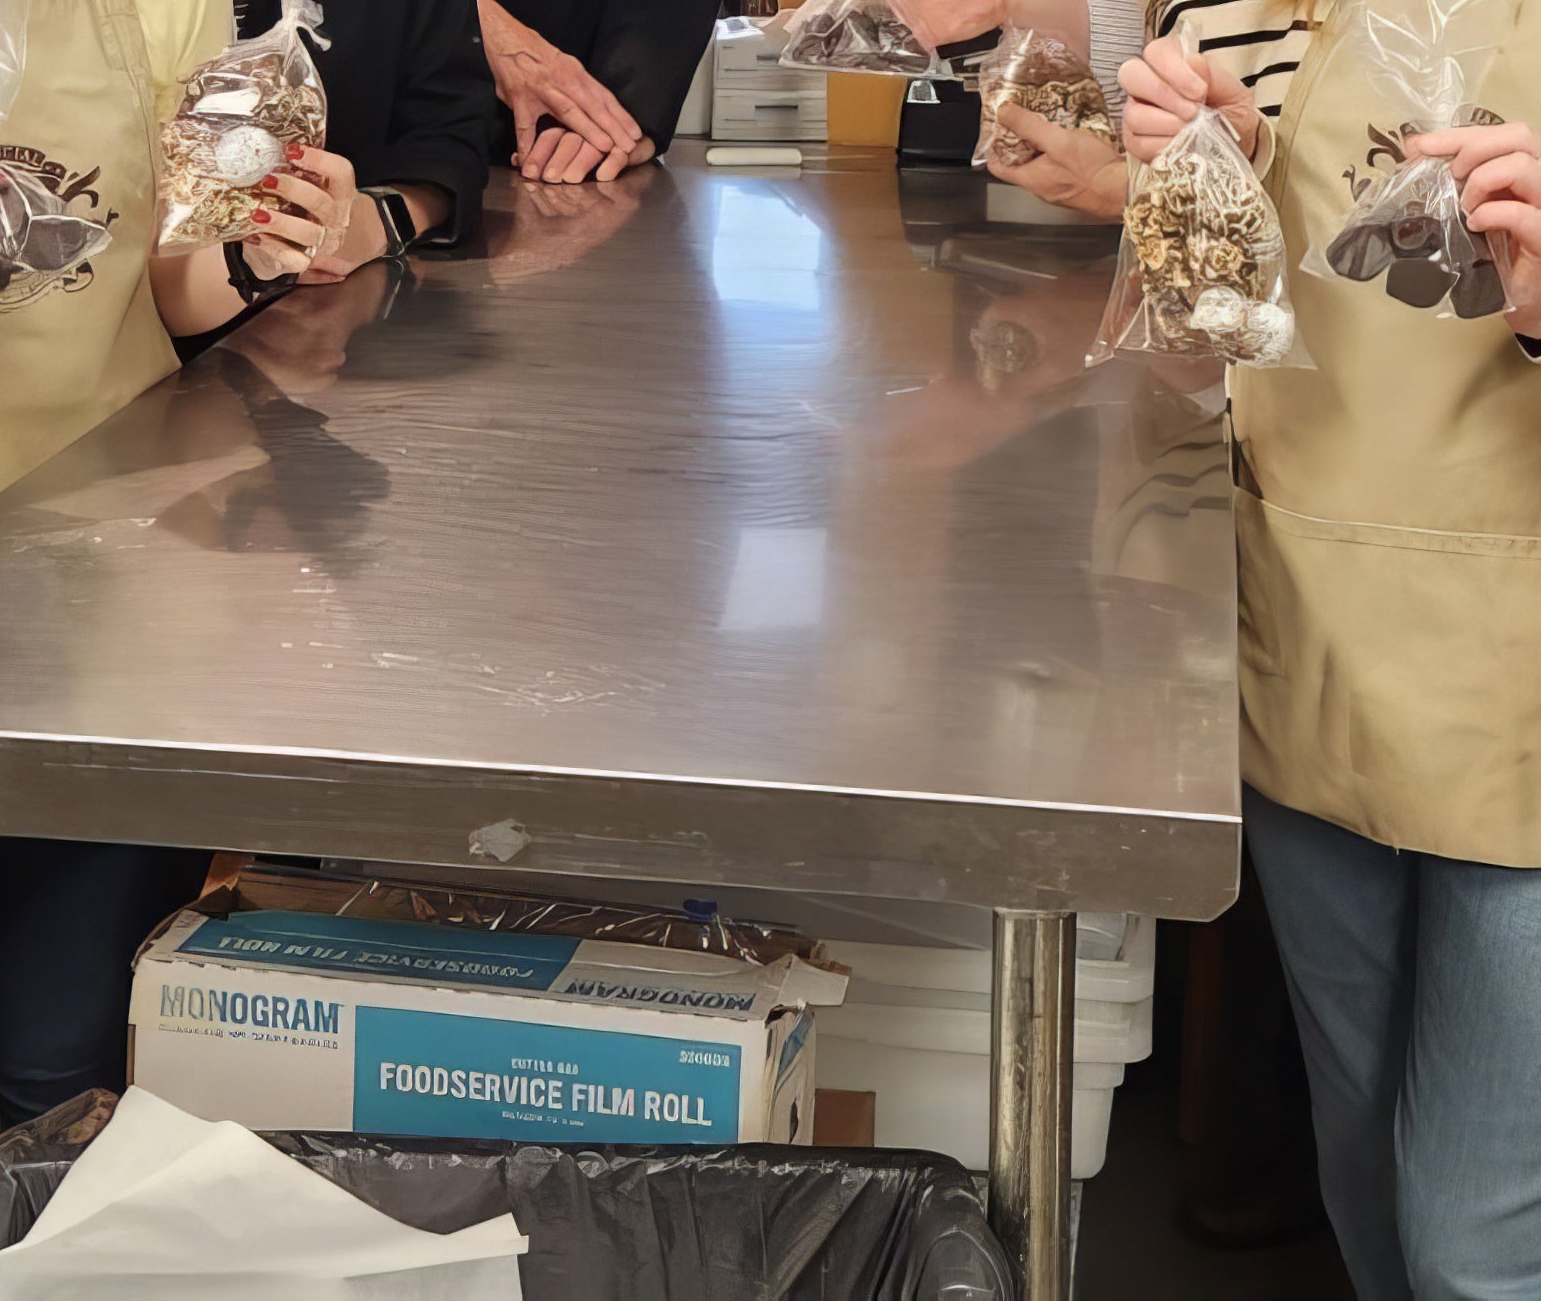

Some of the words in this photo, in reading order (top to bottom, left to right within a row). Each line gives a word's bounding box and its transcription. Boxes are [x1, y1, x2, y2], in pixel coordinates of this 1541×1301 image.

[160, 984, 340, 1034] MONOGRAM
[379, 1061, 564, 1111] FOODSERVICE
[571, 1083, 635, 1117] FILM
[644, 1090, 713, 1127] ROLL
